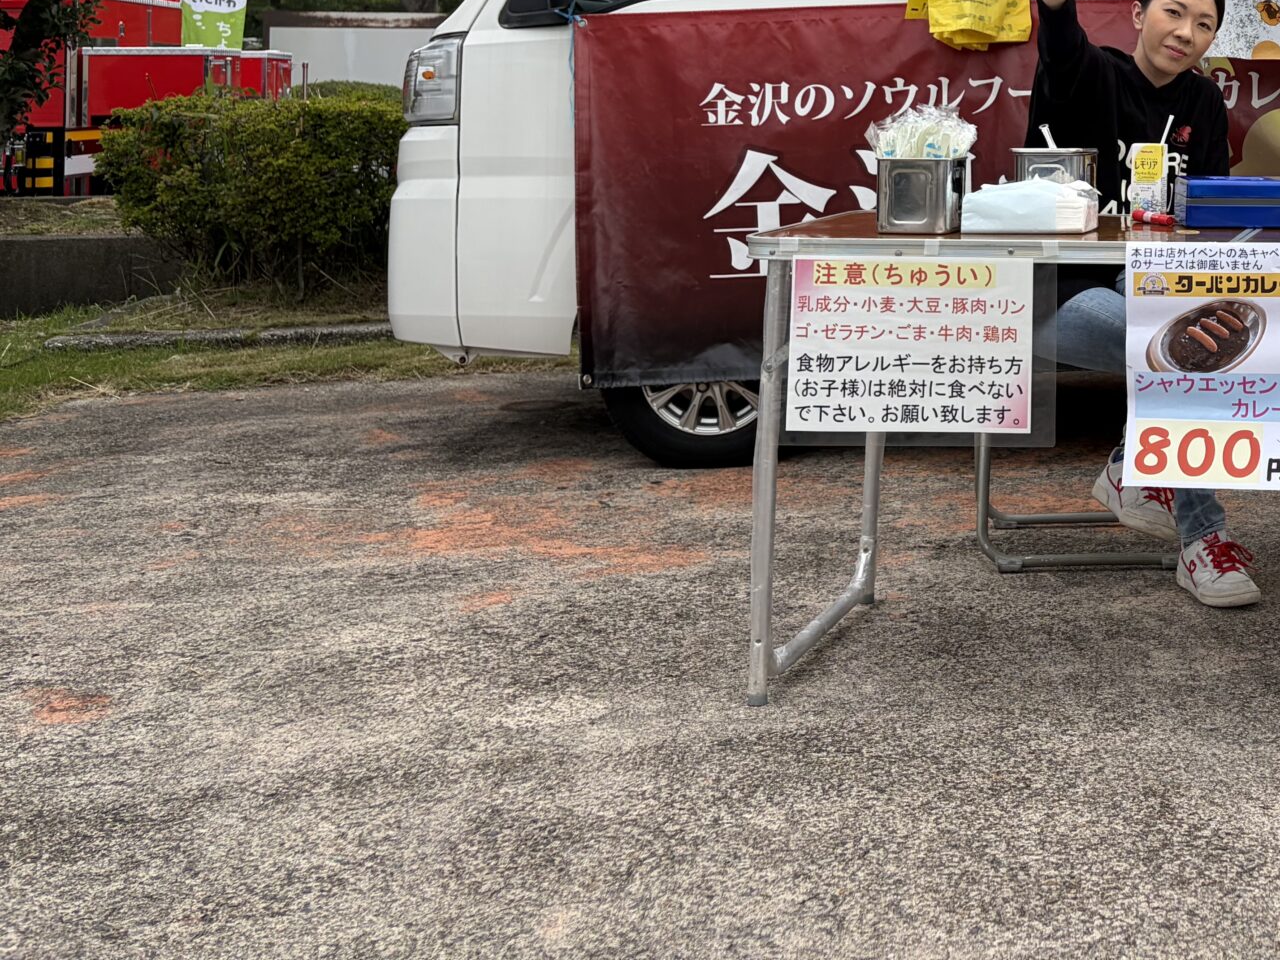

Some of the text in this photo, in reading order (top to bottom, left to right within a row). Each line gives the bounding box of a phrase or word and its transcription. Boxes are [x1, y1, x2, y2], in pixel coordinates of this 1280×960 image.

[1131, 259, 1263, 271] のサービスは御座いません
[796, 353, 1024, 375] 食物アレルギーをお持ち方
[794, 379, 1024, 400] (お子様)は絶対に食べない
[1135, 373, 1278, 395] シャウエッセン
[794, 403, 1021, 426] で下さい。お願い致します。
